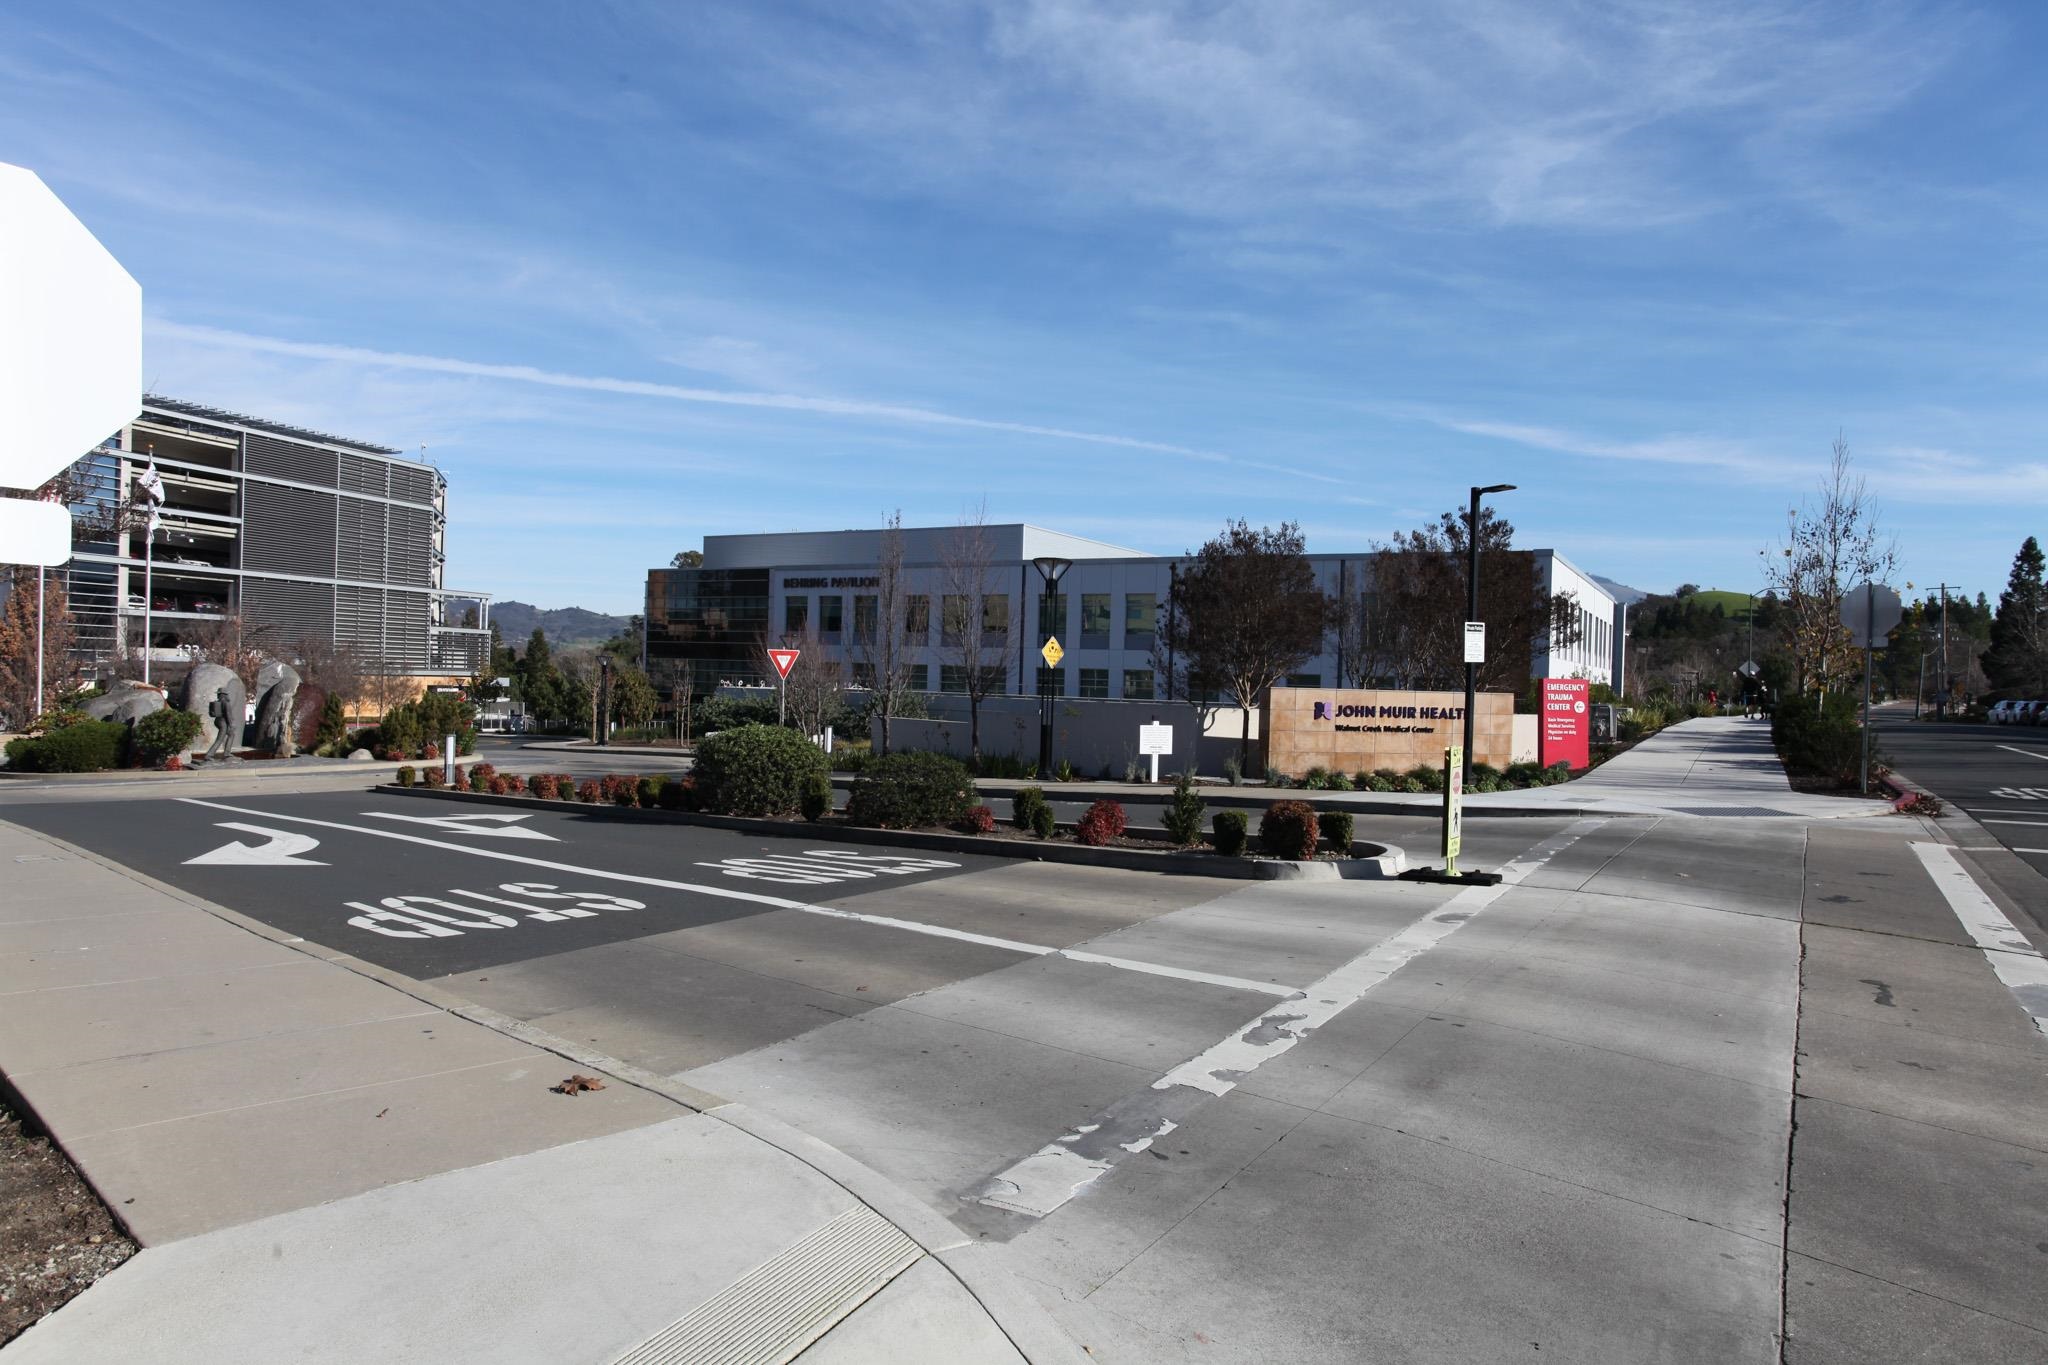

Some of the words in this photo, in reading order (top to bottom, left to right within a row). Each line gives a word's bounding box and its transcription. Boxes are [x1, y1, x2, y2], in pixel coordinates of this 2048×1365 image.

[831, 576, 880, 588] PAVILION
[1335, 704, 1376, 719] JOHN
[1379, 705, 1417, 720] MUIR
[1335, 724, 1361, 732] Walnut
[1362, 724, 1382, 733] Creek
[1383, 725, 1410, 733] Medical
[1411, 726, 1435, 734] Center
[693, 850, 962, 884] STOP
[342, 882, 646, 939] STOP
